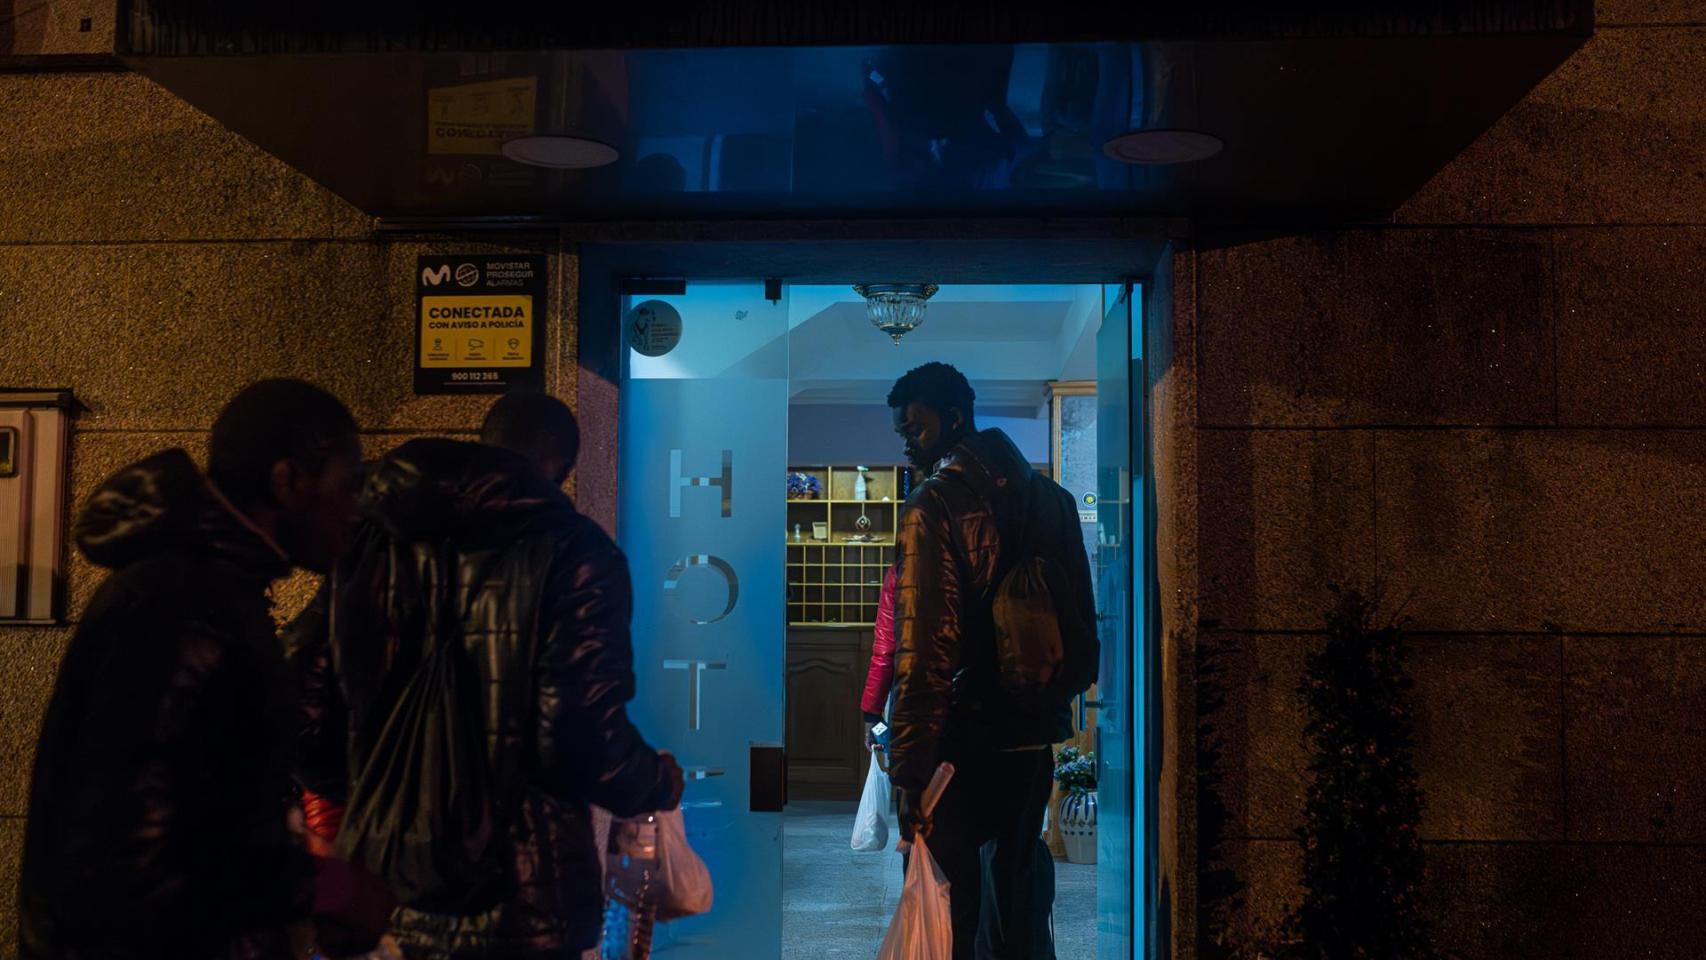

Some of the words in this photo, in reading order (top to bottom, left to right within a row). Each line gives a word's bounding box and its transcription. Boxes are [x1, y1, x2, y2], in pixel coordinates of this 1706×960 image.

[486, 262, 530, 270] MOVISTAR
[486, 270, 534, 278] PROSEGUR
[429, 306, 524, 319] CONECTADA
[428, 321, 449, 329] CON
[451, 321, 479, 329] AVISO
[480, 321, 488, 329] A
[488, 319, 524, 328] POLICÍA
[451, 371, 468, 381] 900
[469, 371, 479, 381] 112
